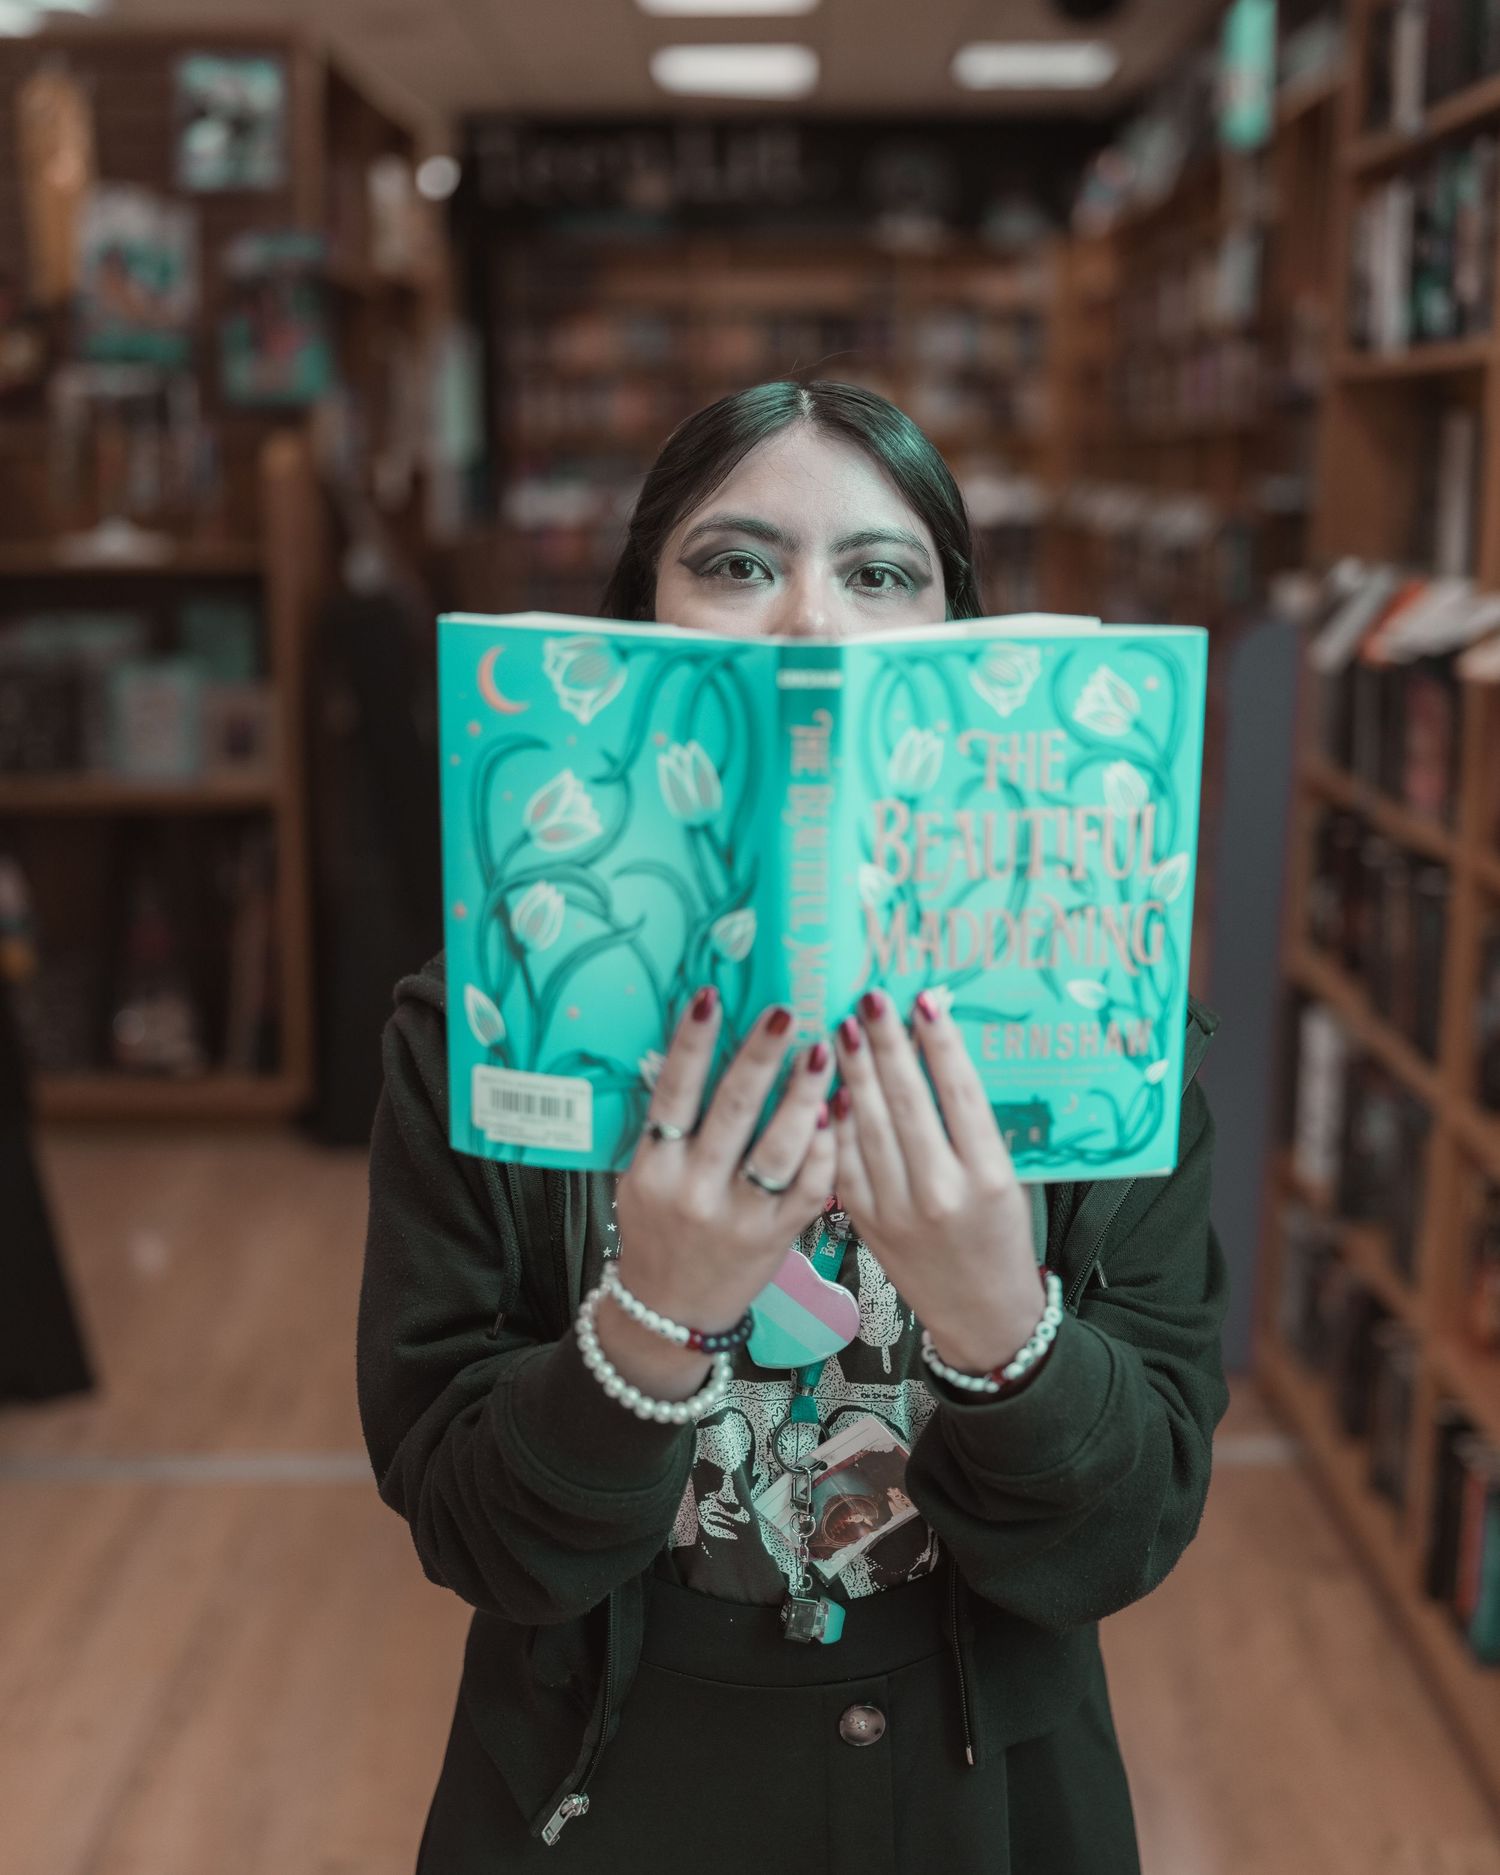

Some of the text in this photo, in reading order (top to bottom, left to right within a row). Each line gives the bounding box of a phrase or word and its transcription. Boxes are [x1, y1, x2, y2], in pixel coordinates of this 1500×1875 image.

[956, 728, 1068, 793] THE
[872, 800, 1167, 900] BEAUTIFUL
[852, 892, 1165, 992] MADDENING
[981, 1017, 1153, 1060] ERNSHAW
